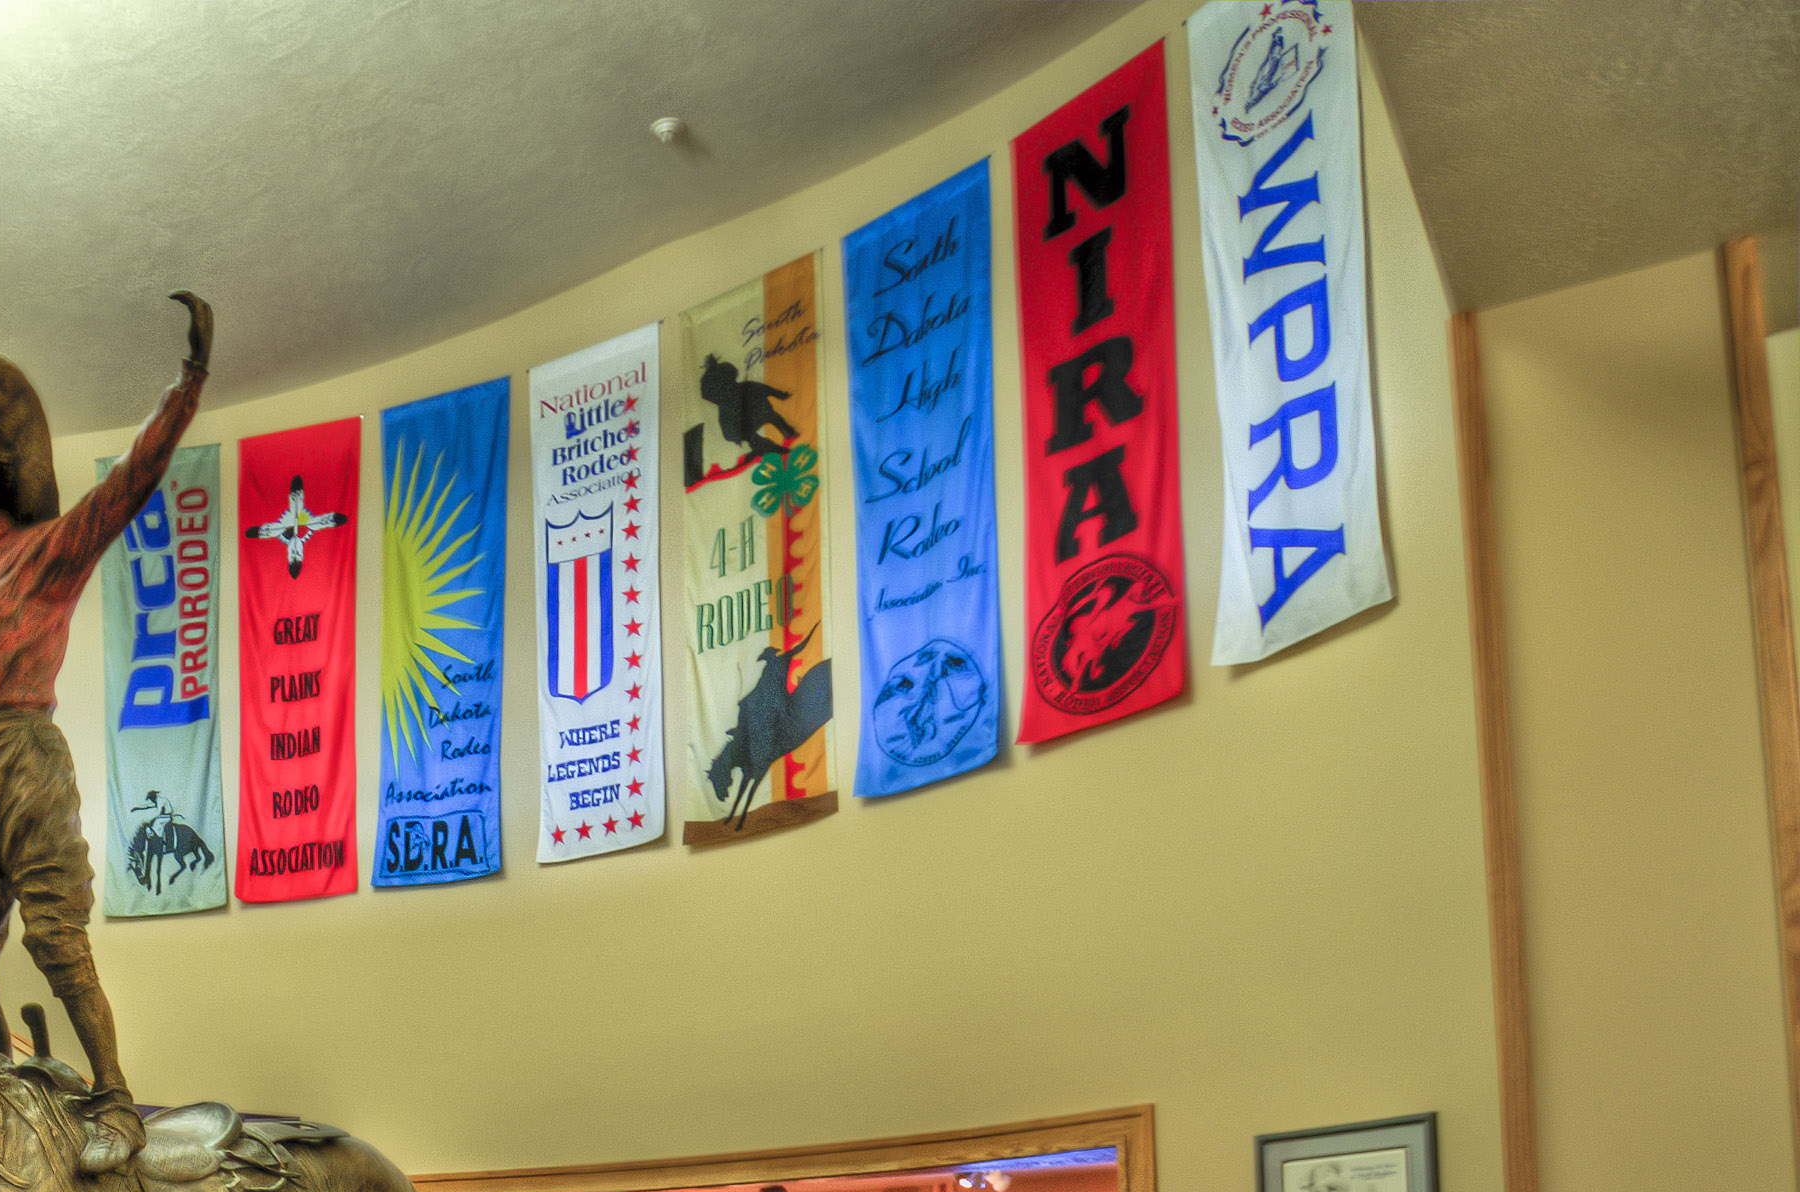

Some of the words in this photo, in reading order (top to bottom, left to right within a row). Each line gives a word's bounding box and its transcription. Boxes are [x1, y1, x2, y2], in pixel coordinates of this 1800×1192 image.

[872, 216, 960, 298] South
[741, 299, 804, 348] South
[861, 292, 973, 367] Dakota
[1042, 103, 1144, 567] NIRA
[744, 324, 819, 374] Dakota
[540, 361, 646, 419] National
[876, 345, 964, 423] High
[1237, 108, 1346, 637] WPRA
[564, 398, 625, 439] Little
[552, 420, 640, 466] Britches
[864, 414, 974, 504] School
[546, 467, 642, 506] Association
[562, 449, 632, 486] Rodeo
[709, 515, 755, 578] 4-H
[877, 502, 963, 565] Rodeo
[175, 487, 210, 699] PRORODEO
[273, 614, 321, 645] GREAT
[696, 573, 794, 655] RODEO
[270, 670, 322, 703] PLAINS
[441, 659, 494, 689] South
[429, 701, 492, 729] Dakota
[558, 719, 620, 749] WHERE
[270, 726, 321, 761] INDIAN
[441, 736, 492, 762] Rodeo
[547, 751, 621, 783] LEGENDS
[273, 784, 320, 819] RODEO
[384, 777, 492, 808] Association
[569, 784, 621, 811] BEGIN
[250, 840, 345, 877] ASSOCIATION
